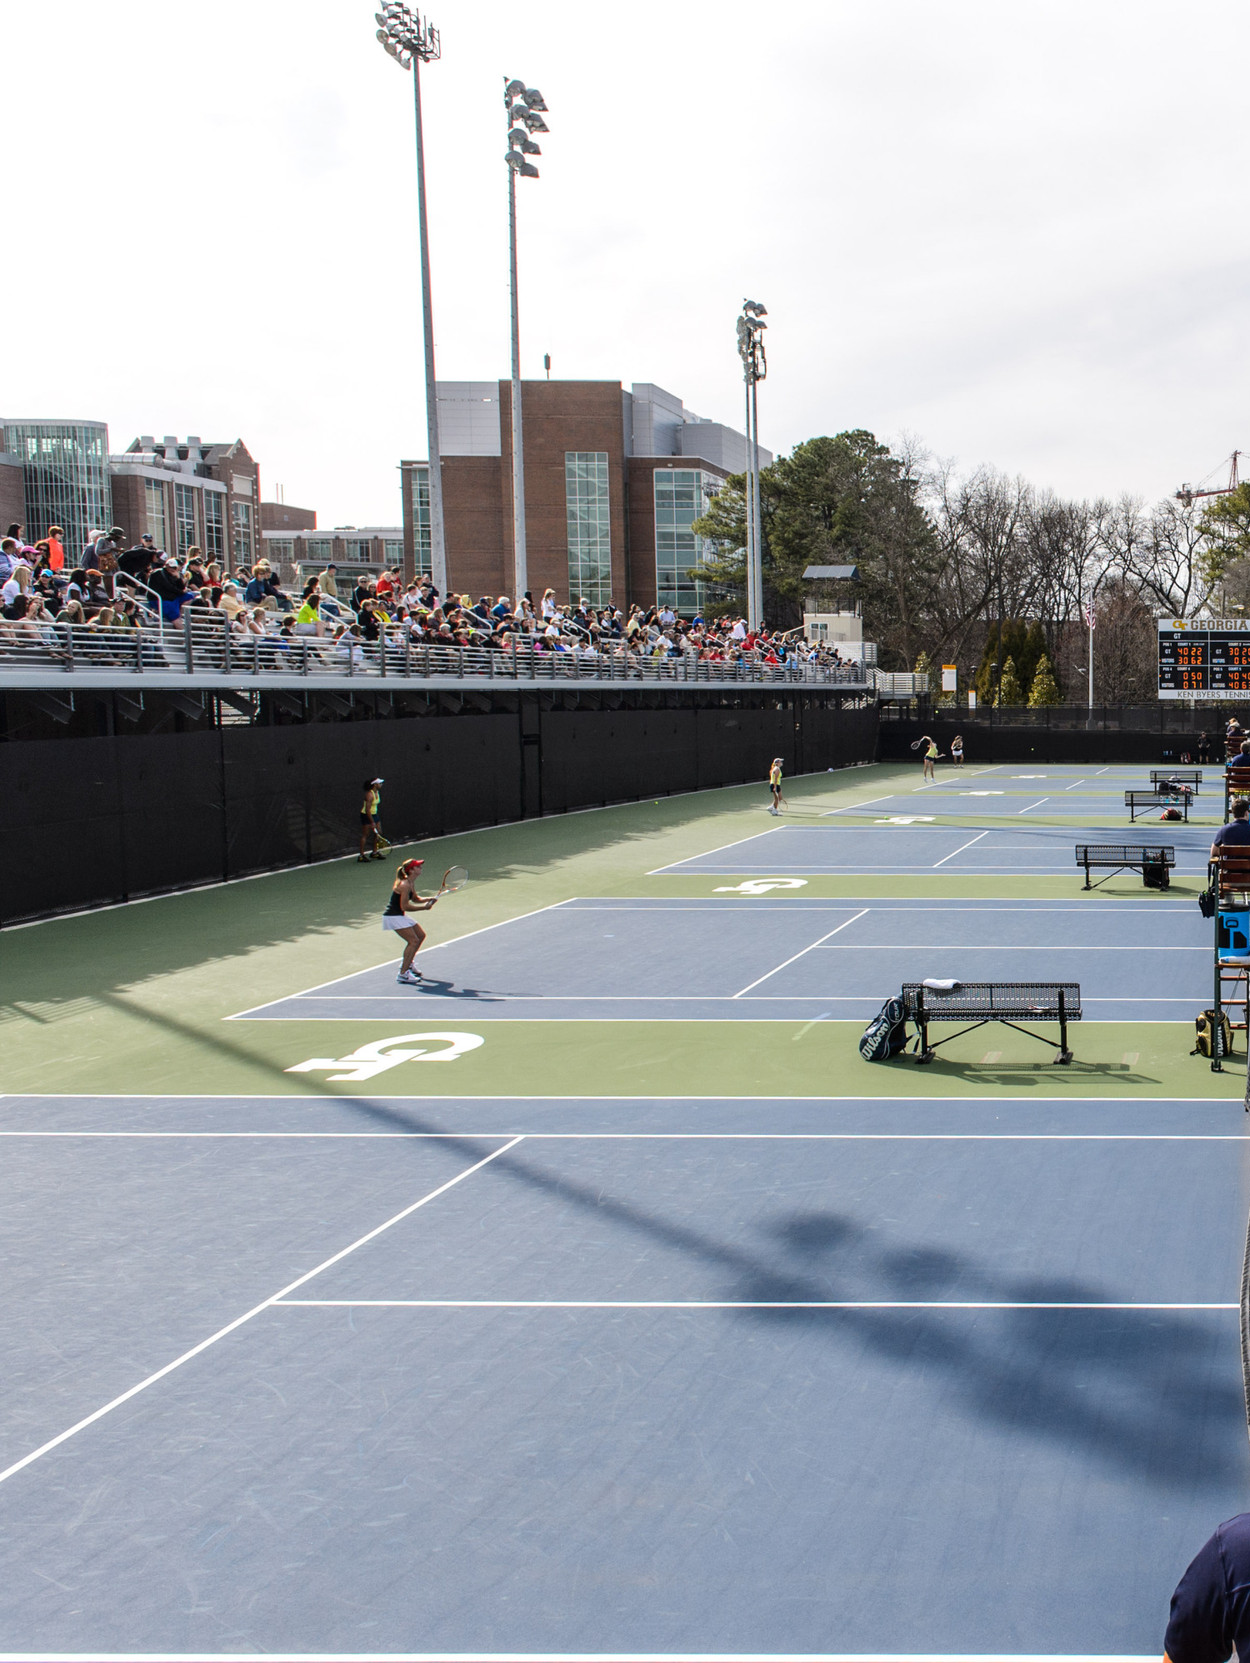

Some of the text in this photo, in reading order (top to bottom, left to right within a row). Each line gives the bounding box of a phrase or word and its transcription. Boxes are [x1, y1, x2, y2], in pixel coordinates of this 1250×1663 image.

[1172, 620, 1188, 630] GT
[1190, 620, 1248, 630] GEORGIA
[283, 1032, 485, 1081] GT
[861, 1022, 889, 1060] Wilson
